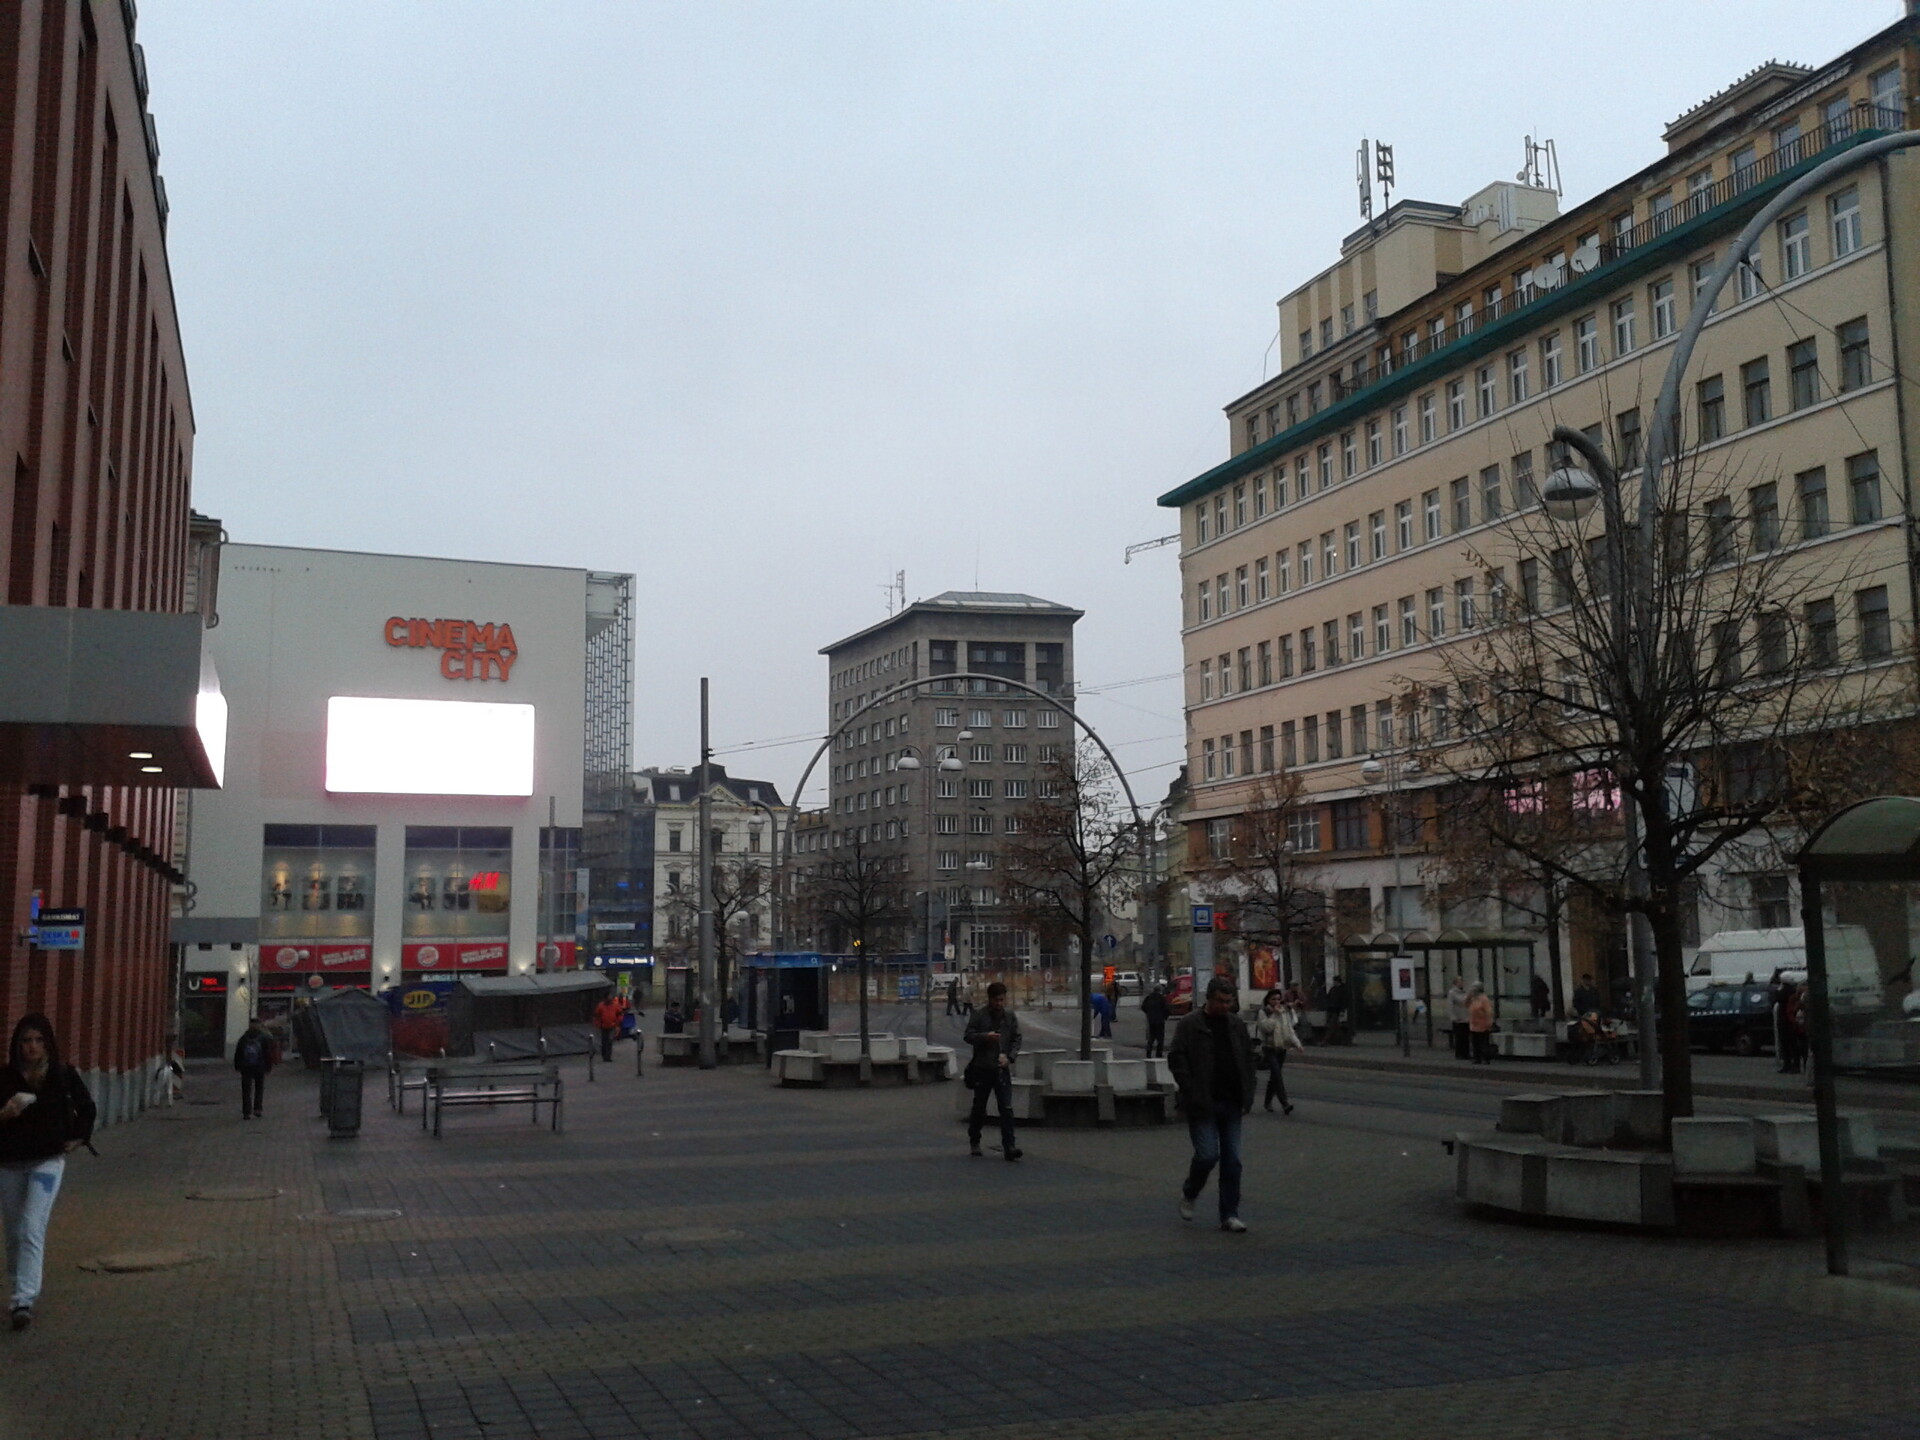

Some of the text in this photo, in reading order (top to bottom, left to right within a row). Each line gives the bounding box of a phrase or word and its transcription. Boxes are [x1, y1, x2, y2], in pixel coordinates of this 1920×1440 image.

[385, 617, 518, 652] CINEMA
[440, 649, 518, 681] CITY
[409, 993, 431, 1005] JIP
